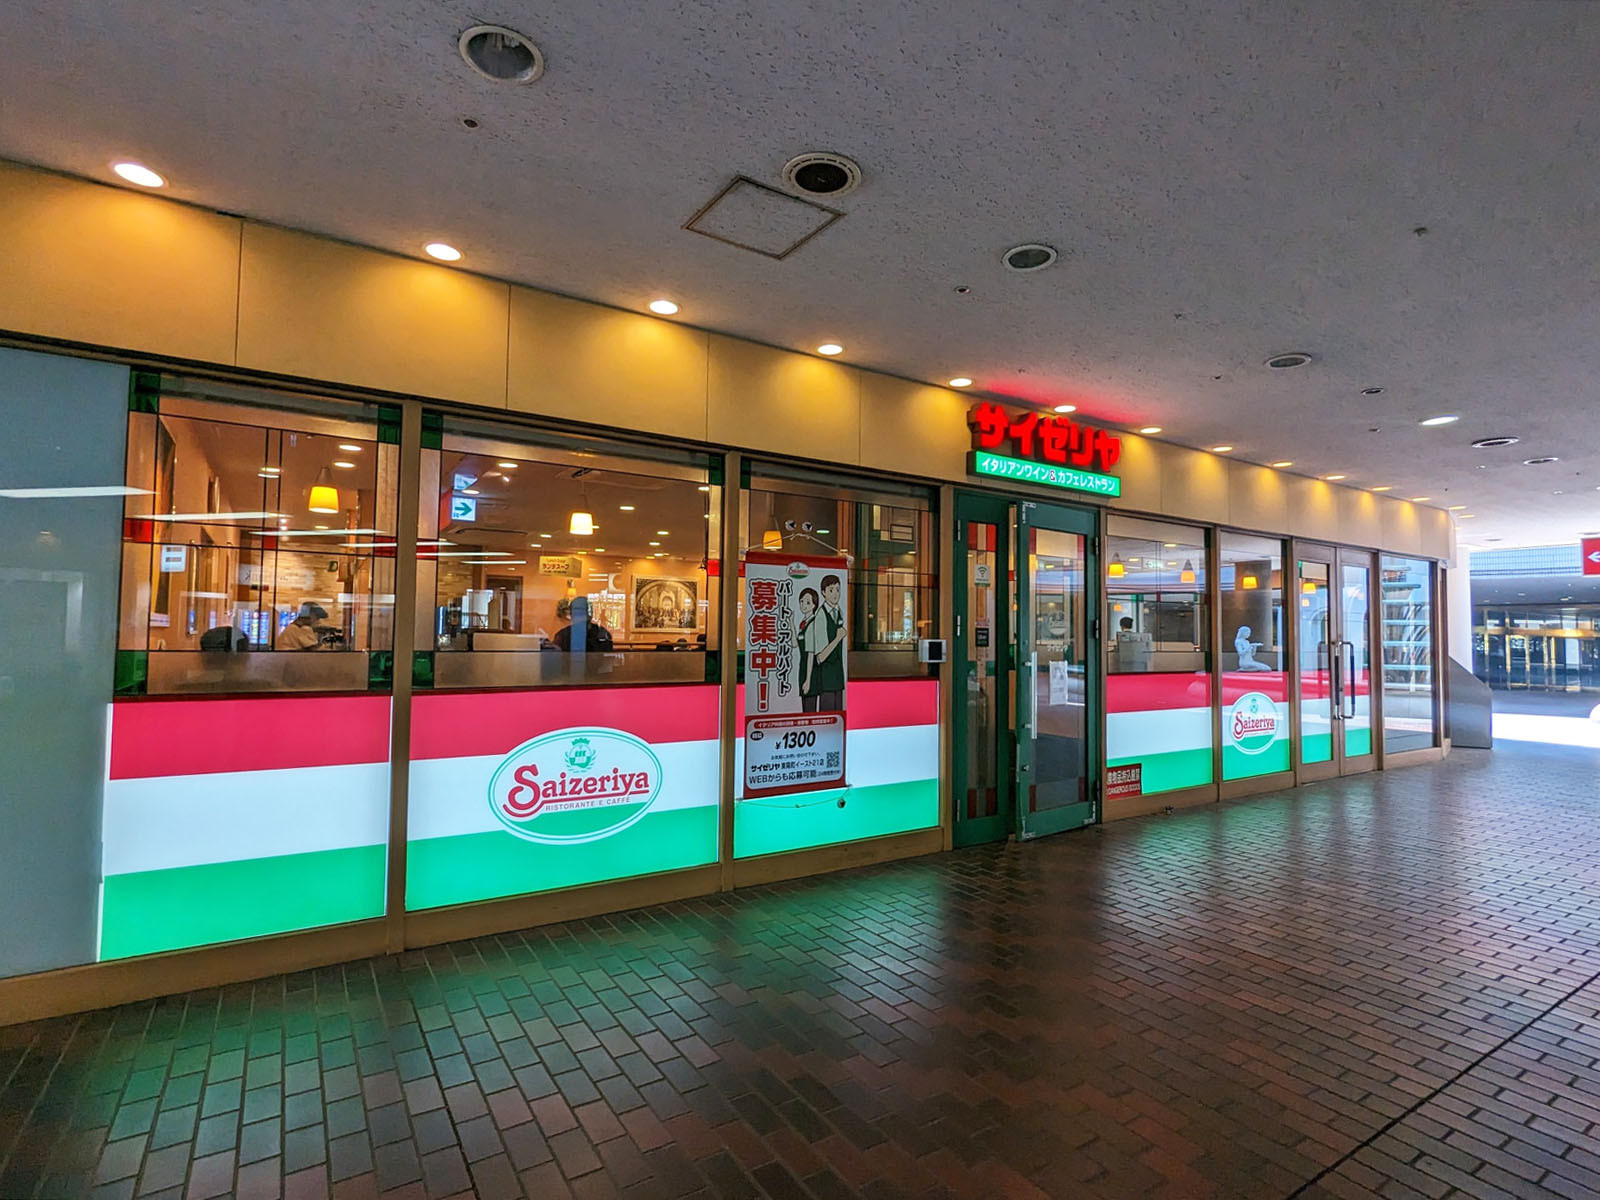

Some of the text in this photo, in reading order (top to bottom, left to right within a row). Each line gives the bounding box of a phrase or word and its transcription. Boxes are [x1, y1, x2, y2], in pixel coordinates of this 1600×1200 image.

[975, 402, 1121, 472] サイゼリヤ
[1234, 711, 1275, 737] Saizeriya
[506, 764, 649, 812] Saizeriya
[545, 800, 595, 811] RISTORANTE
